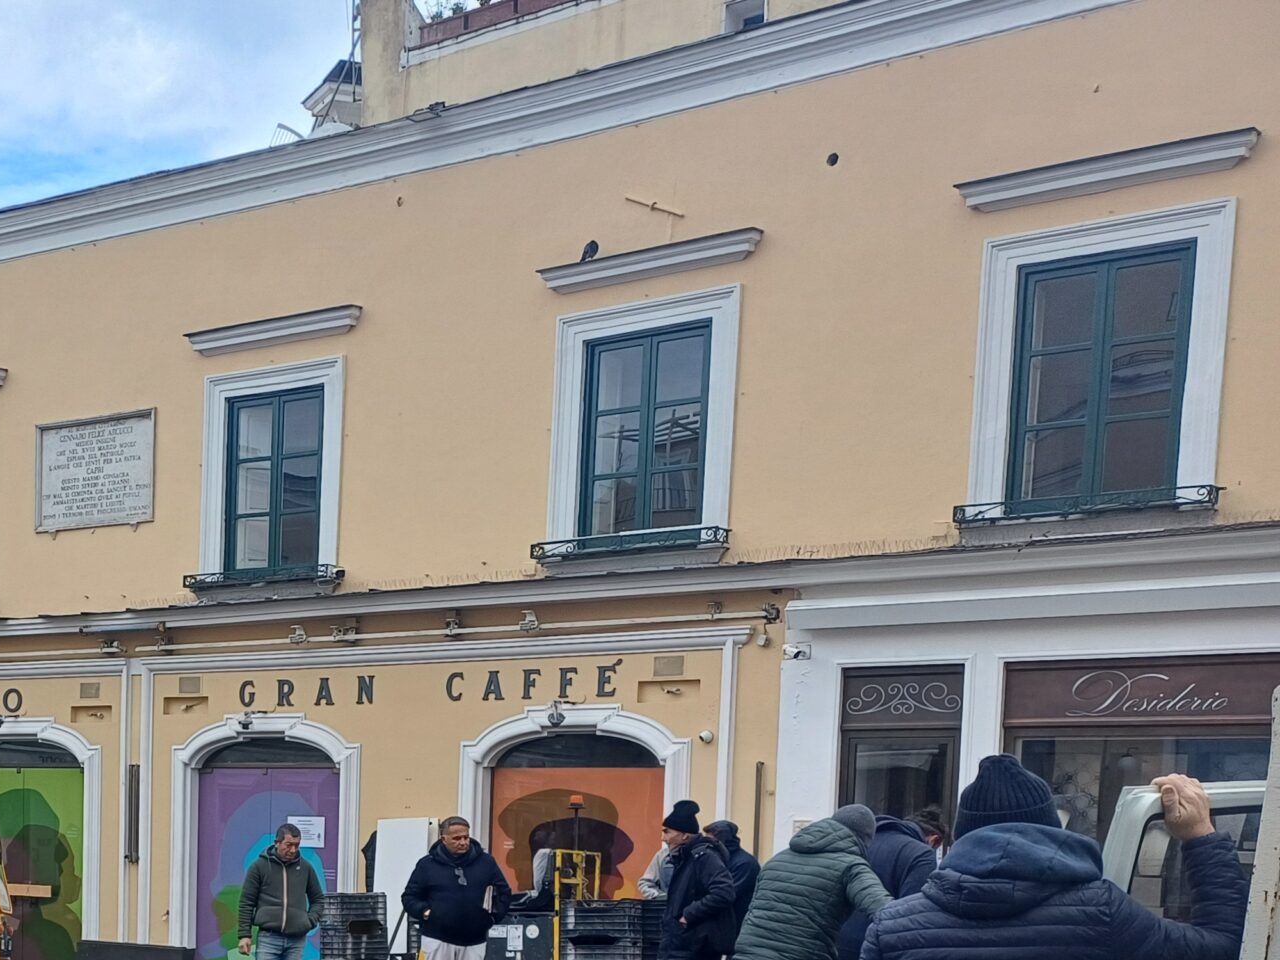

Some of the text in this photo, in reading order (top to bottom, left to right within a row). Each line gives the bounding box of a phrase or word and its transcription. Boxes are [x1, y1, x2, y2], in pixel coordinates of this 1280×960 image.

[88, 430, 105, 439] FELICE
[239, 675, 375, 707] GRAN
[1065, 671, 1229, 716] Desiderio
